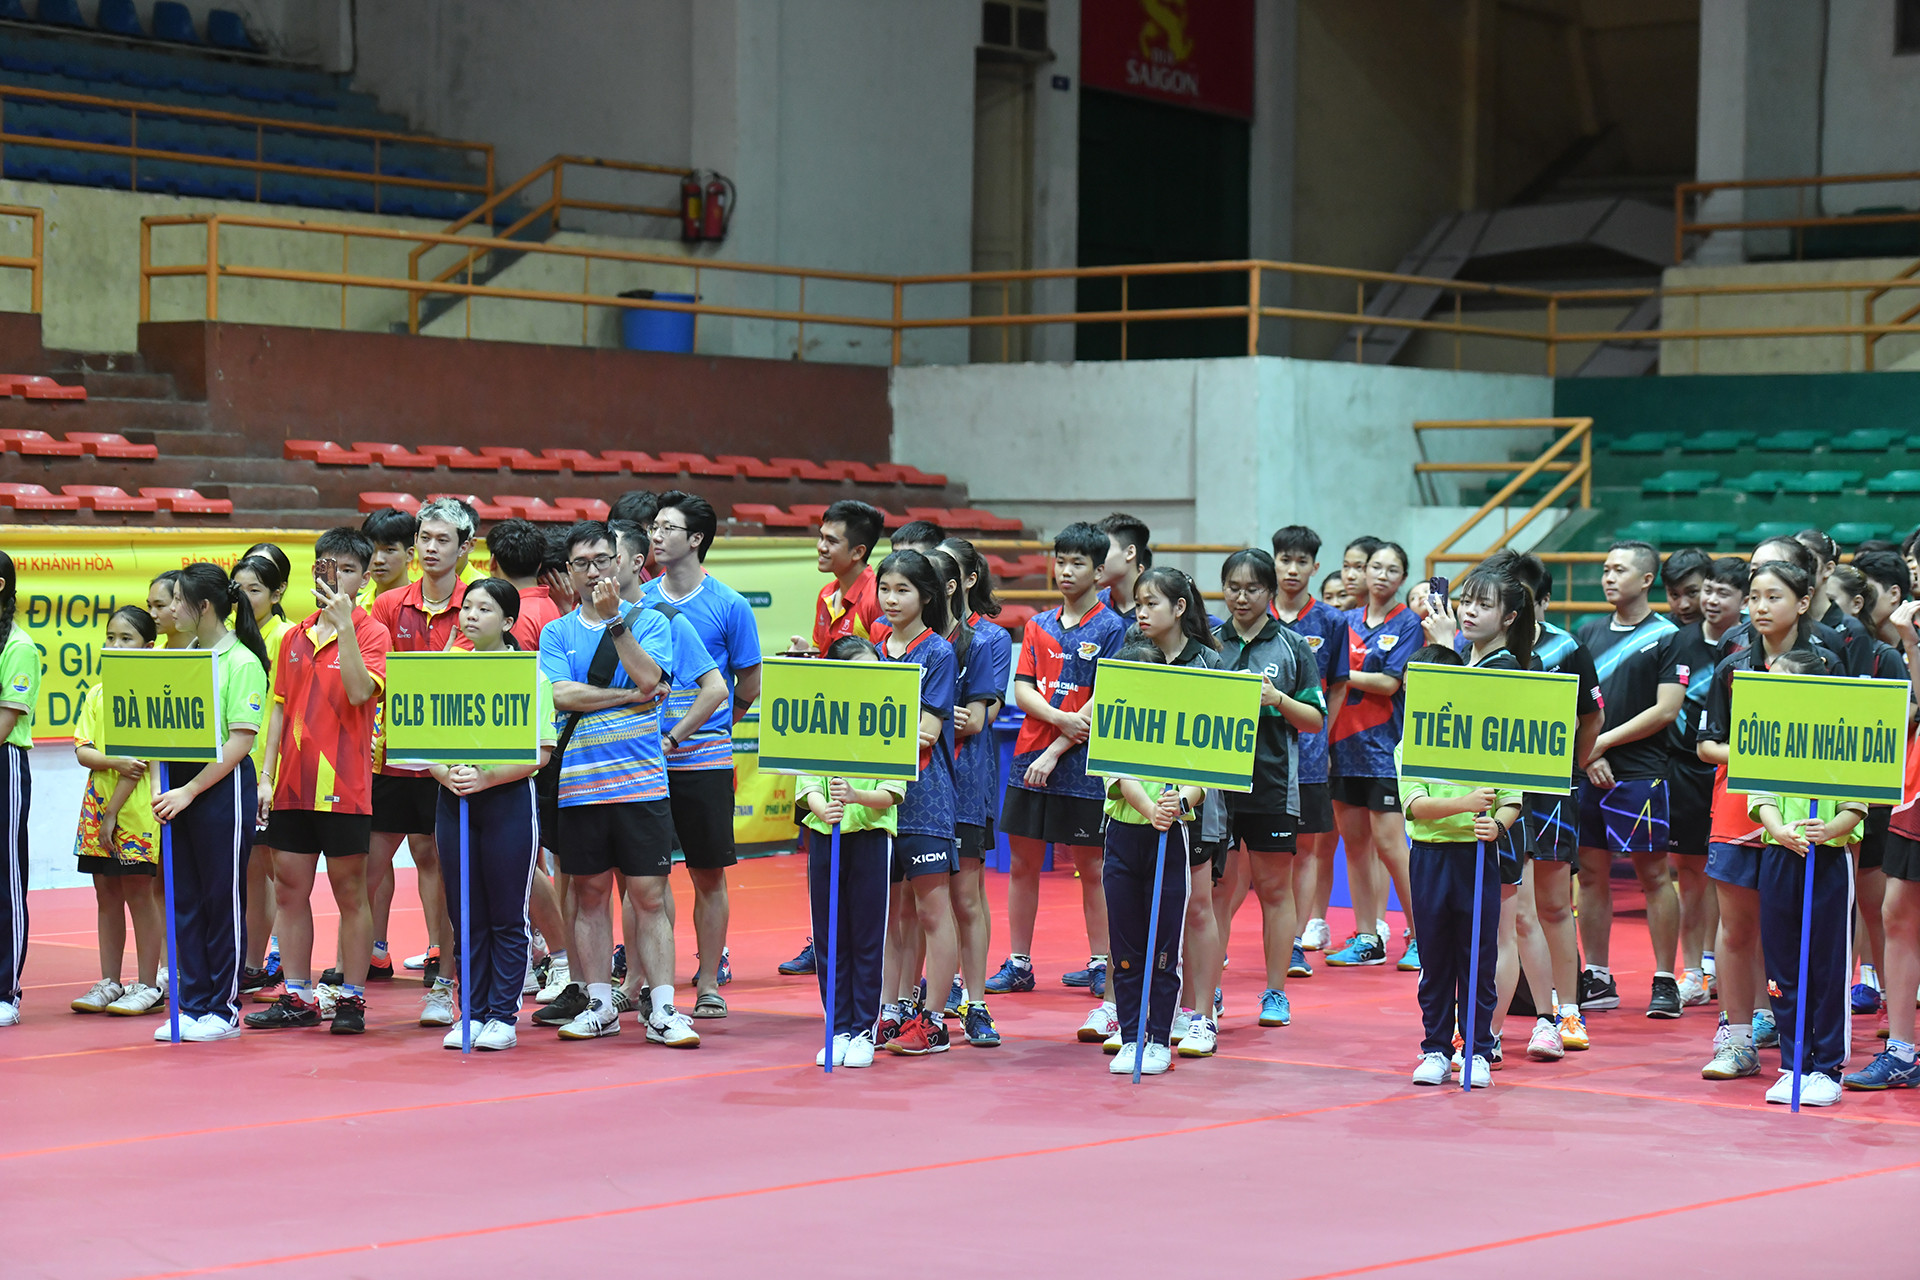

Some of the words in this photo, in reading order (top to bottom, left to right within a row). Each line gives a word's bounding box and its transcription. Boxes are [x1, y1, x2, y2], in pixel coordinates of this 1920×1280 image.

[1126, 58, 1200, 96] SAIGON
[85, 553, 114, 571] HÒA
[25, 594, 116, 637] ĐỊCH
[113, 689, 141, 728] ĐÀ
[146, 684, 205, 730] NẴNG
[391, 693, 425, 727] CLB
[430, 693, 486, 727] TIMES
[492, 693, 531, 727] CITY
[772, 692, 850, 736] QUÂN
[858, 695, 907, 746] ĐỘI
[1097, 698, 1167, 744] VĨNH
[1175, 711, 1255, 753] LONG
[1412, 701, 1473, 749] TIỀN
[1481, 716, 1567, 757] GIANG
[1737, 711, 1781, 757] CÔNG
[1784, 722, 1809, 759] AN
[1812, 717, 1859, 762] NHÂN
[1862, 719, 1897, 764] DÂN
[911, 851, 948, 865] XIOM
